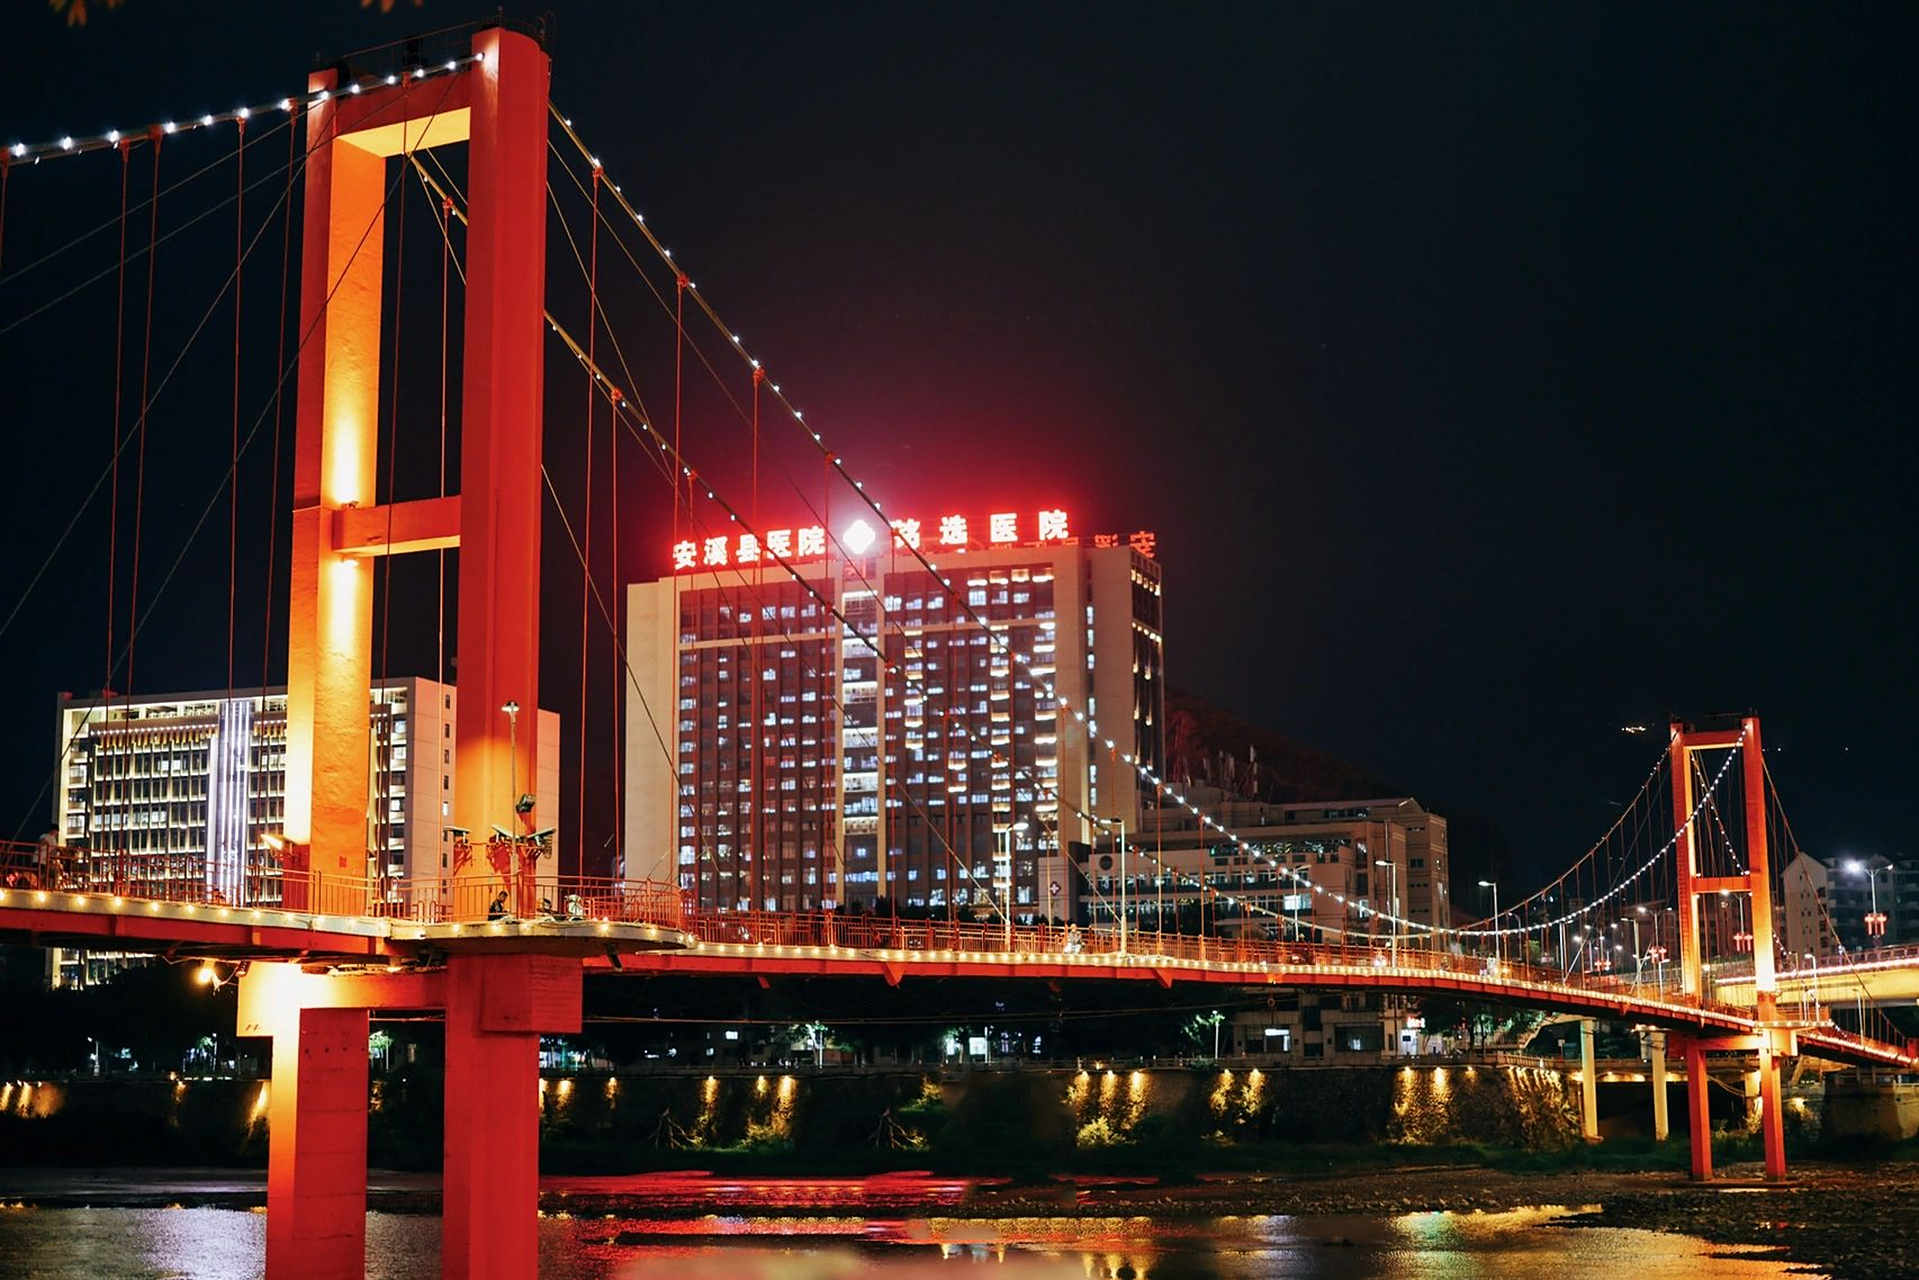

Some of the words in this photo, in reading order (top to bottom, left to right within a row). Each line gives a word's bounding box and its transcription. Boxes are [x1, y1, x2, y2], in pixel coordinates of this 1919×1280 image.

[672, 525, 826, 570] 安溪县医院
